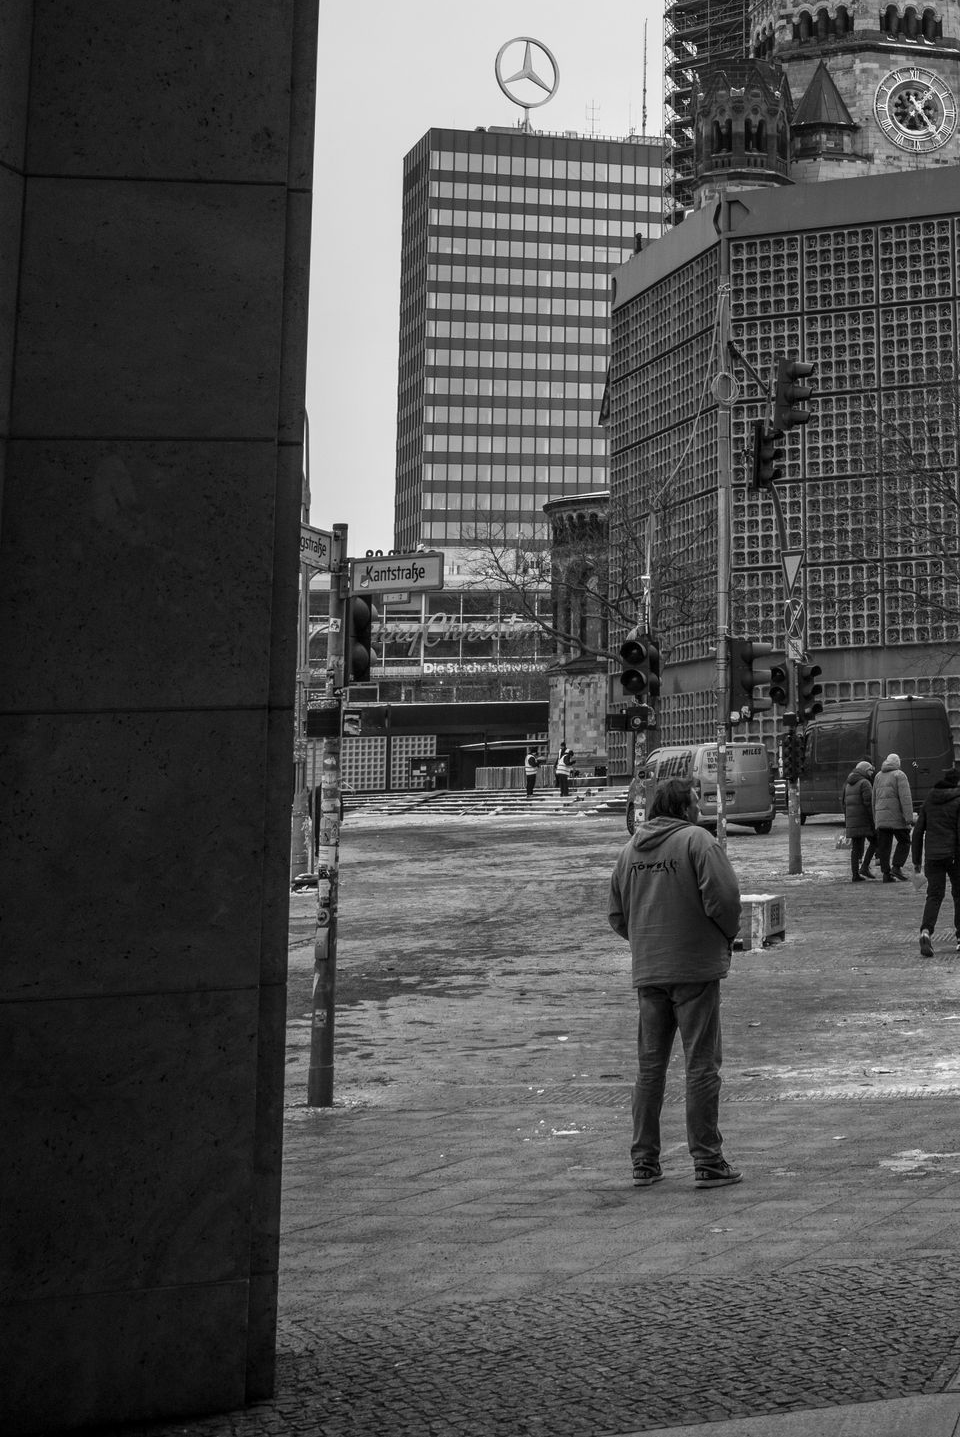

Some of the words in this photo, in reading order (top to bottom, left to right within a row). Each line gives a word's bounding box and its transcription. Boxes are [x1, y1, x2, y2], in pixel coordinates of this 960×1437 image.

[366, 562, 425, 583] Kantstraße
[423, 662, 445, 673] Die
[742, 748, 761, 756] MILES
